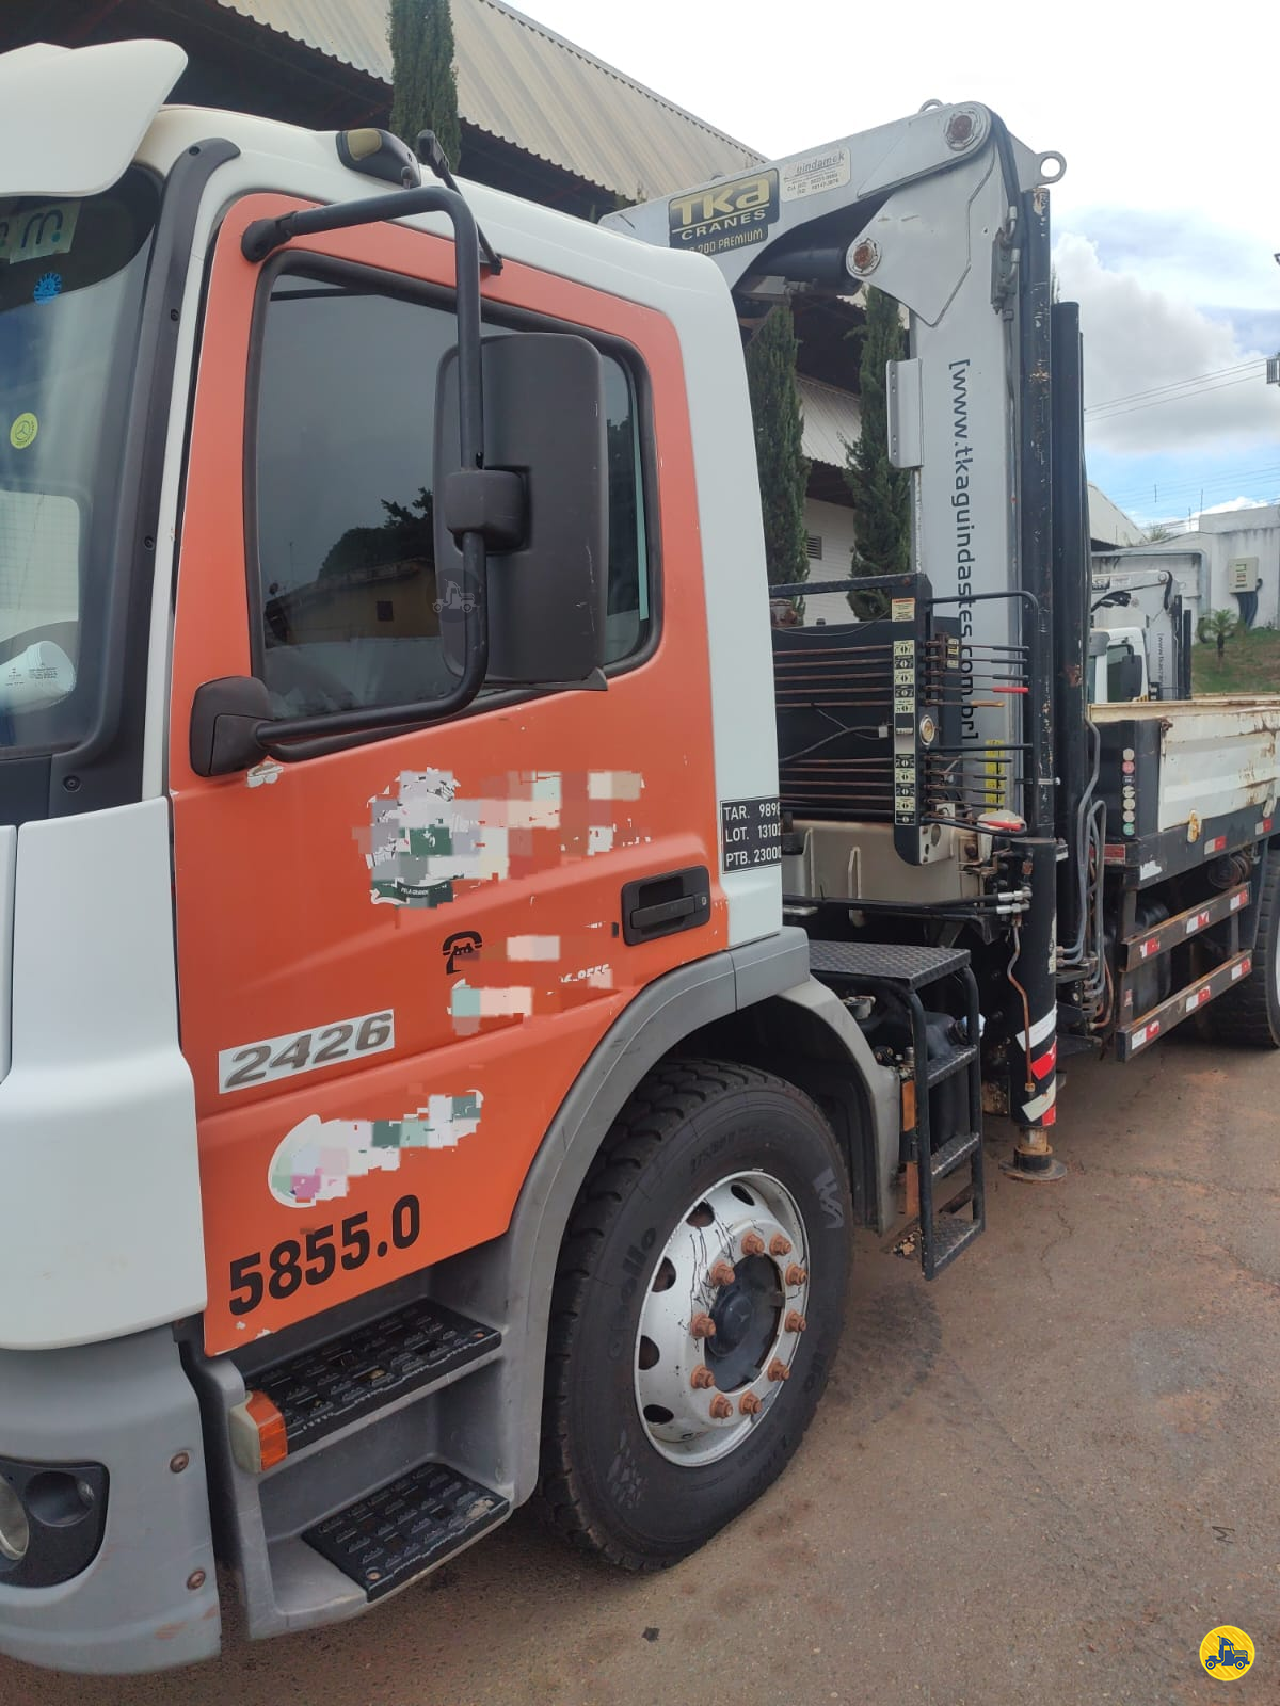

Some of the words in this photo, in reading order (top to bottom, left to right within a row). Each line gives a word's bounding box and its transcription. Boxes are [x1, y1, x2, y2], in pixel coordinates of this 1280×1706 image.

[681, 208, 767, 241] CRANES
[718, 227, 763, 250] PREMIUM
[723, 805, 750, 821] TAR.
[725, 826, 750, 842] LOT.
[725, 851, 751, 868] PTB.
[225, 1013, 394, 1089] 2426
[229, 1193, 420, 1317] 5855.0
